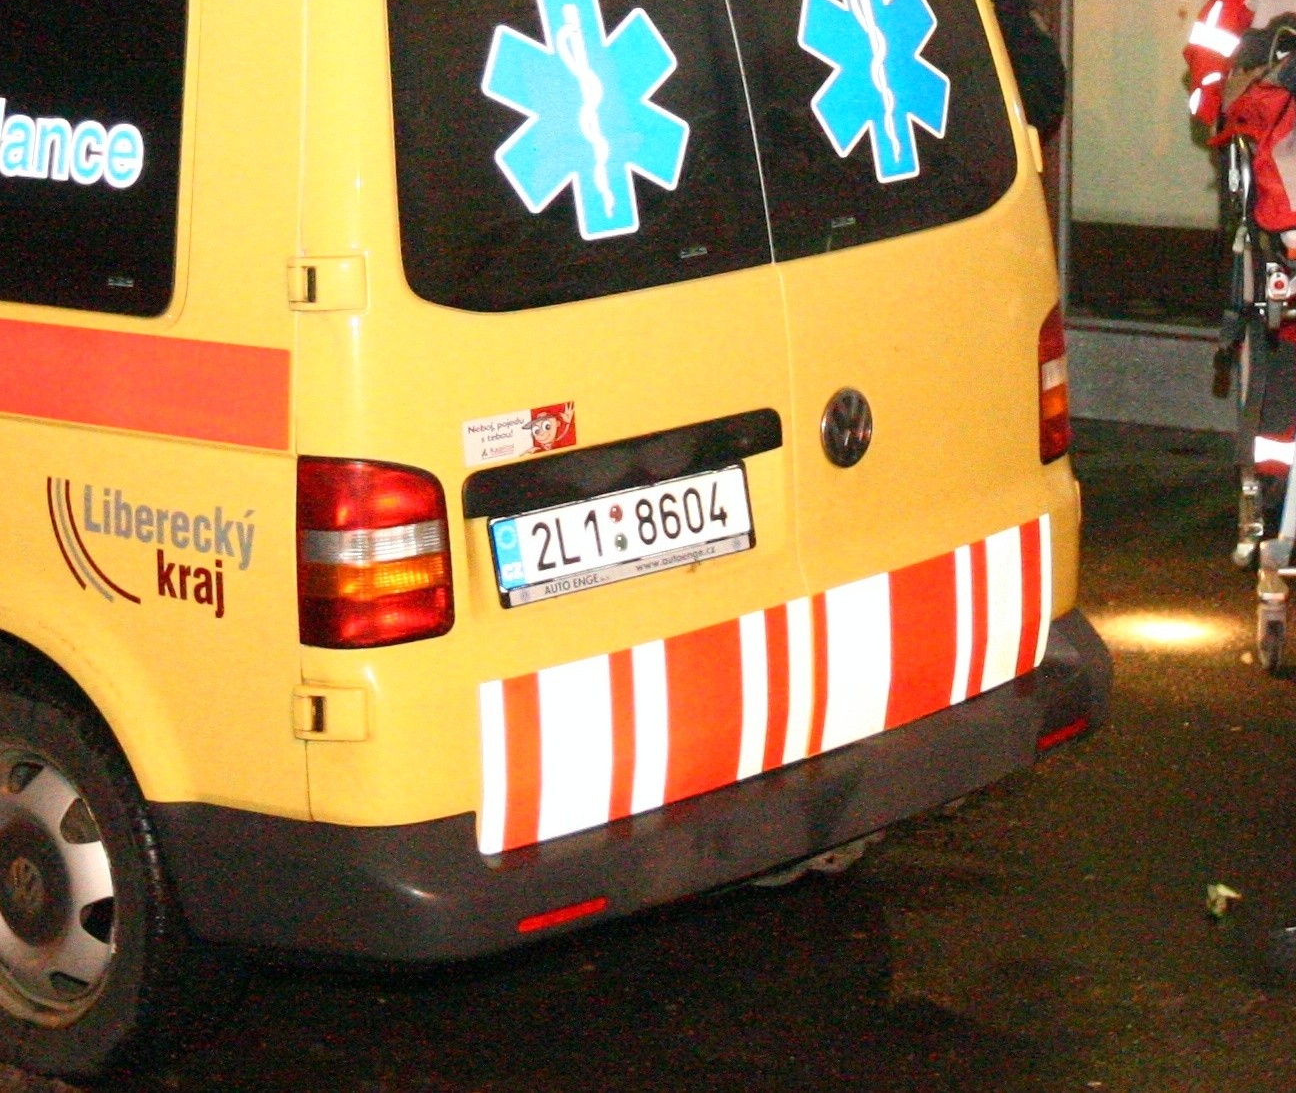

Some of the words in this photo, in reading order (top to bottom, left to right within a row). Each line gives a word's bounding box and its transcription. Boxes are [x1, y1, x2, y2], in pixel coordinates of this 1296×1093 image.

[83, 484, 256, 571] Liberecký
[531, 509, 603, 572] 2L1
[634, 481, 729, 545] 8604
[635, 545, 716, 572] www.autoenge.cz
[156, 548, 225, 619] kraj
[544, 578, 572, 595] AUTO
[573, 573, 599, 590] ENGE
